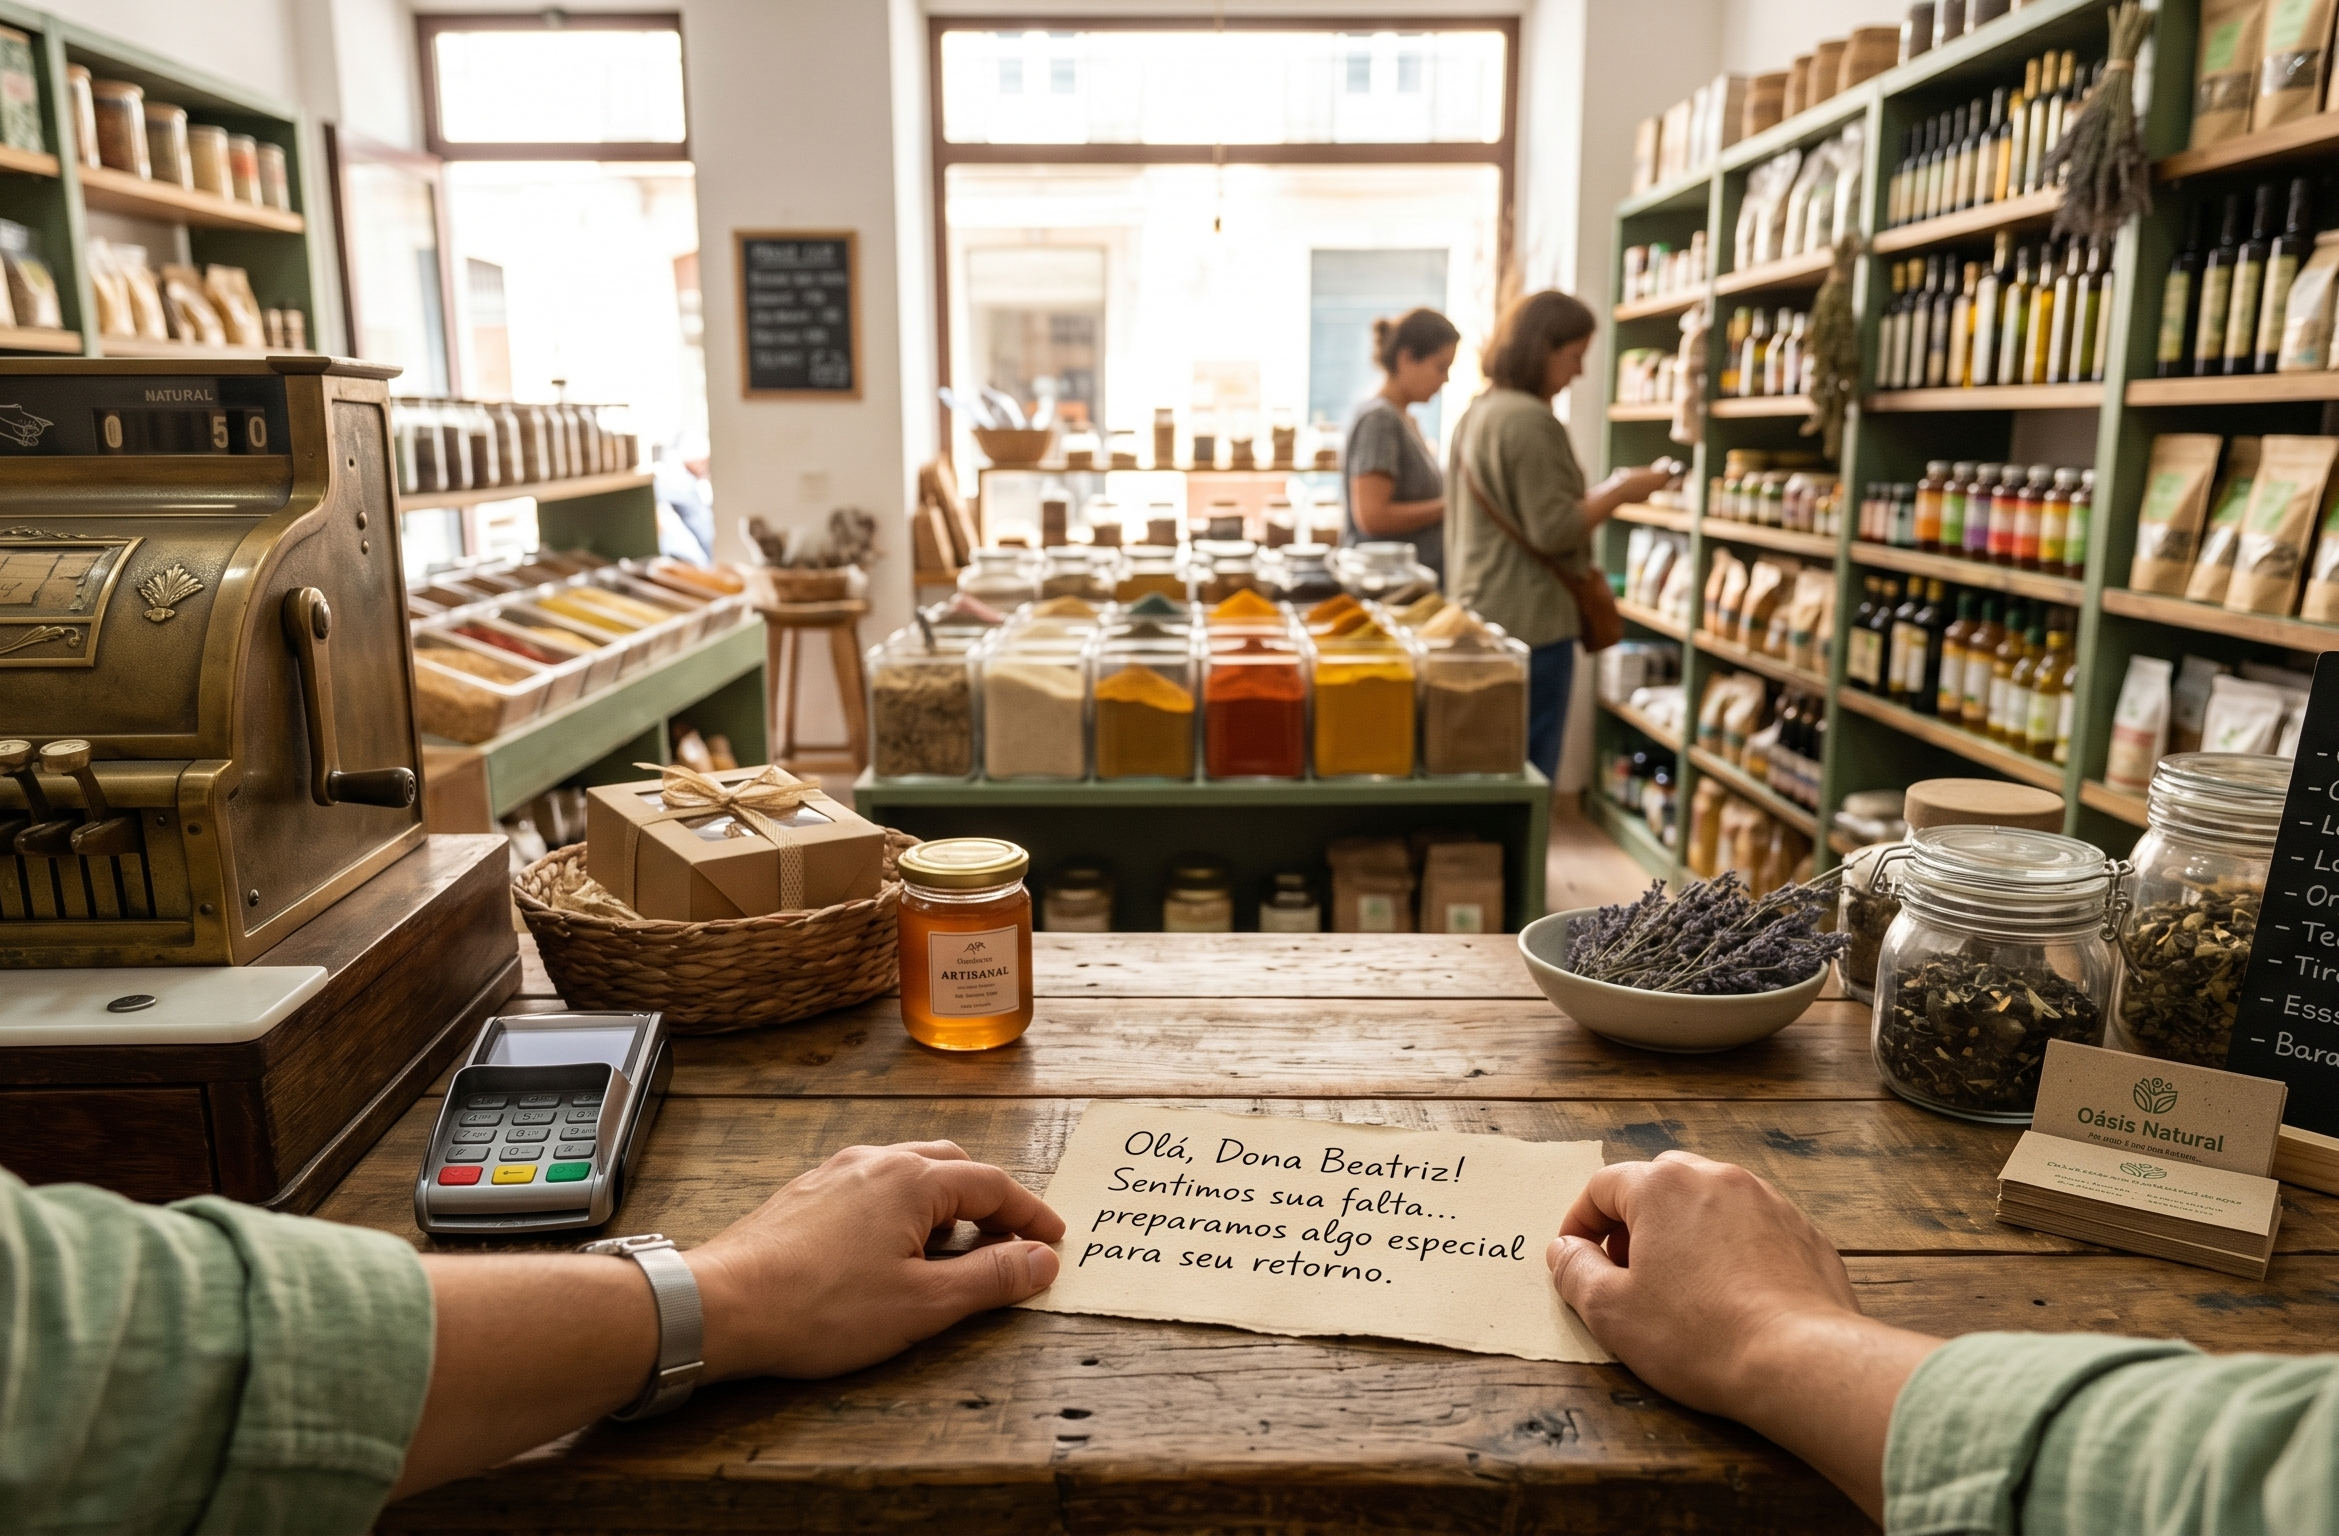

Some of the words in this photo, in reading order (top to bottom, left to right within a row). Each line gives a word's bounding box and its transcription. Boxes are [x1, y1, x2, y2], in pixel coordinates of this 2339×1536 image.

[145, 389, 213, 402] NATURAL
[2321, 814, 2339, 836] L
[2301, 920, 2339, 947] Te
[941, 966, 1009, 980] ARTISANAL
[2294, 954, 2339, 983] Tir
[2077, 1107, 2136, 1133] Oásis
[2142, 1120, 2224, 1153] Natural
[1124, 1130, 1194, 1165] Olá,
[1215, 1138, 1302, 1170] Dona
[1320, 1147, 1466, 1183] Beatriz!
[1107, 1166, 1256, 1206] Sentimos
[1269, 1191, 1325, 1209] sua
[1341, 1187, 1458, 1220] falta...
[1091, 1208, 1288, 1240] preparamos
[1301, 1218, 1373, 1257] algo
[1387, 1235, 1527, 1262] especial
[1078, 1242, 1163, 1268] para
[1178, 1251, 1235, 1270] seu
[1252, 1250, 1394, 1285] retorno.
